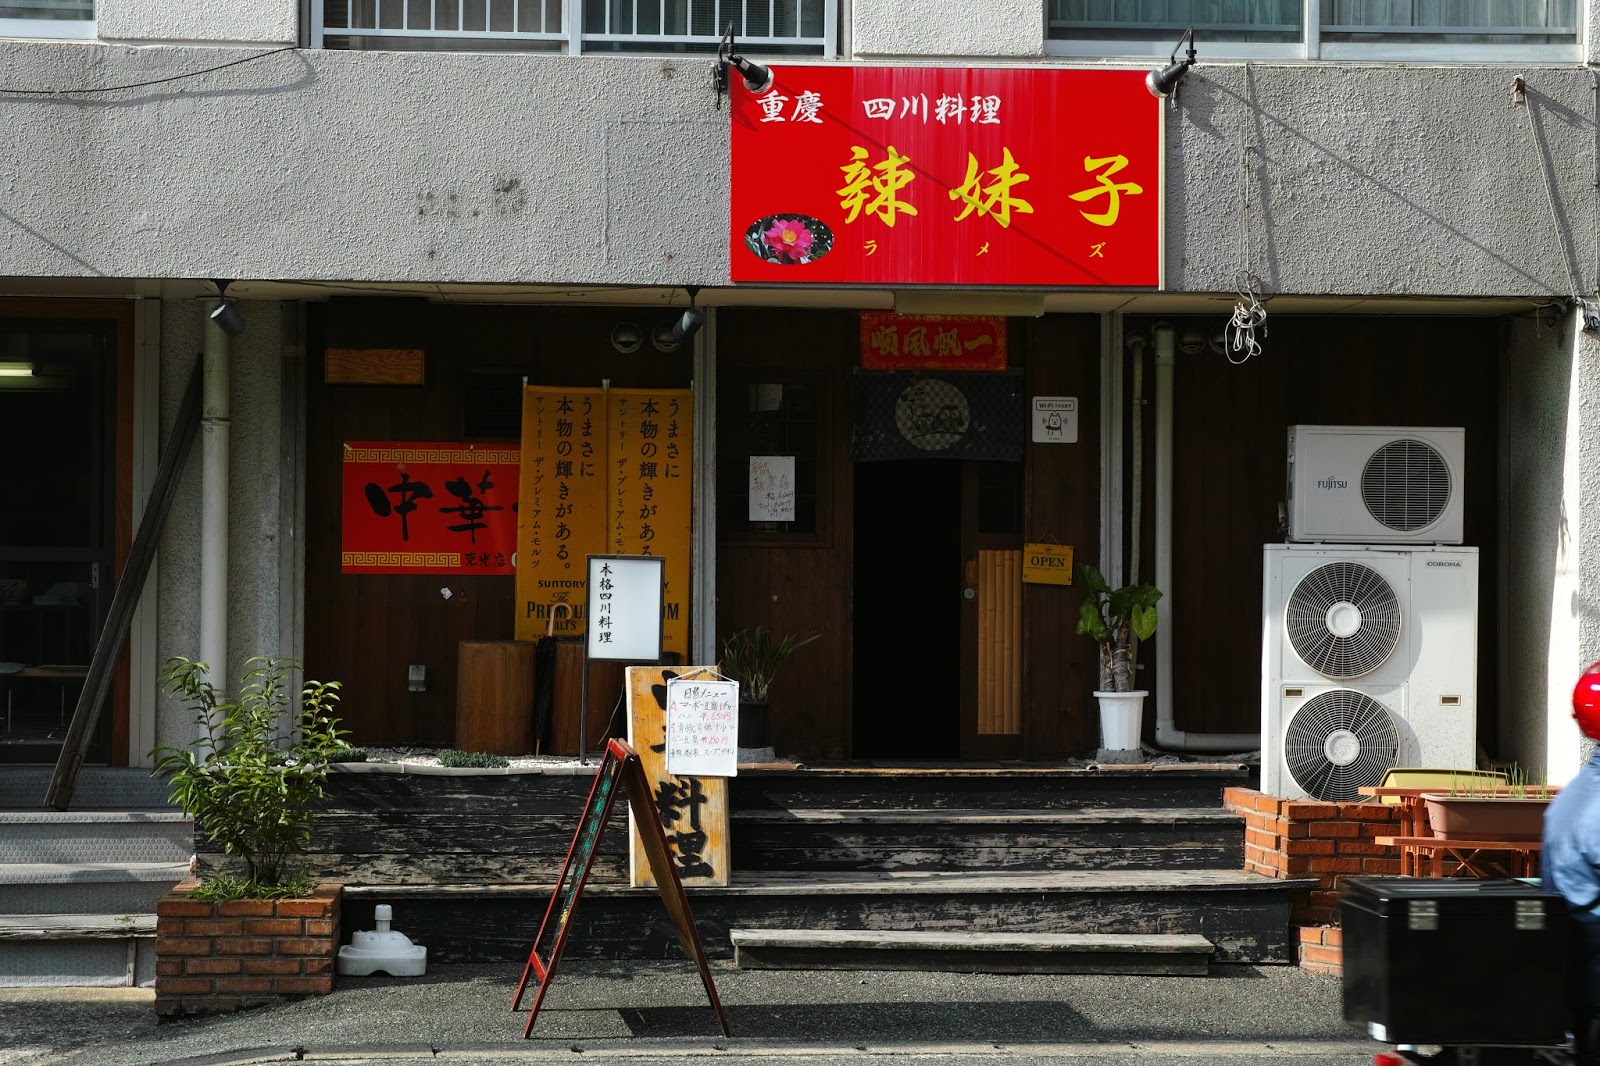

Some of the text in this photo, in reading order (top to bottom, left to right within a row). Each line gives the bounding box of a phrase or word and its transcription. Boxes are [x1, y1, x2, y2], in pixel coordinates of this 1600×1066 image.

[755, 90, 1002, 125] 重慶 四川料理
[835, 145, 1144, 228] 辣妹子
[535, 395, 545, 450] サントリー
[580, 395, 595, 477] うまさに
[618, 398, 628, 452] サントリー
[664, 398, 680, 478] うまさに
[554, 395, 575, 568] 本物の輝きがある。
[1317, 476, 1348, 490] FUJITSU
[364, 470, 520, 544] 中華
[1030, 555, 1066, 568] OPEN
[1426, 559, 1461, 568] CORONA
[537, 580, 586, 588] SUNTORY
[550, 592, 571, 603] The
[597, 562, 614, 644] 本格四川料理
[527, 601, 586, 618] PREMU
[684, 686, 728, 699] 日替メニュー
